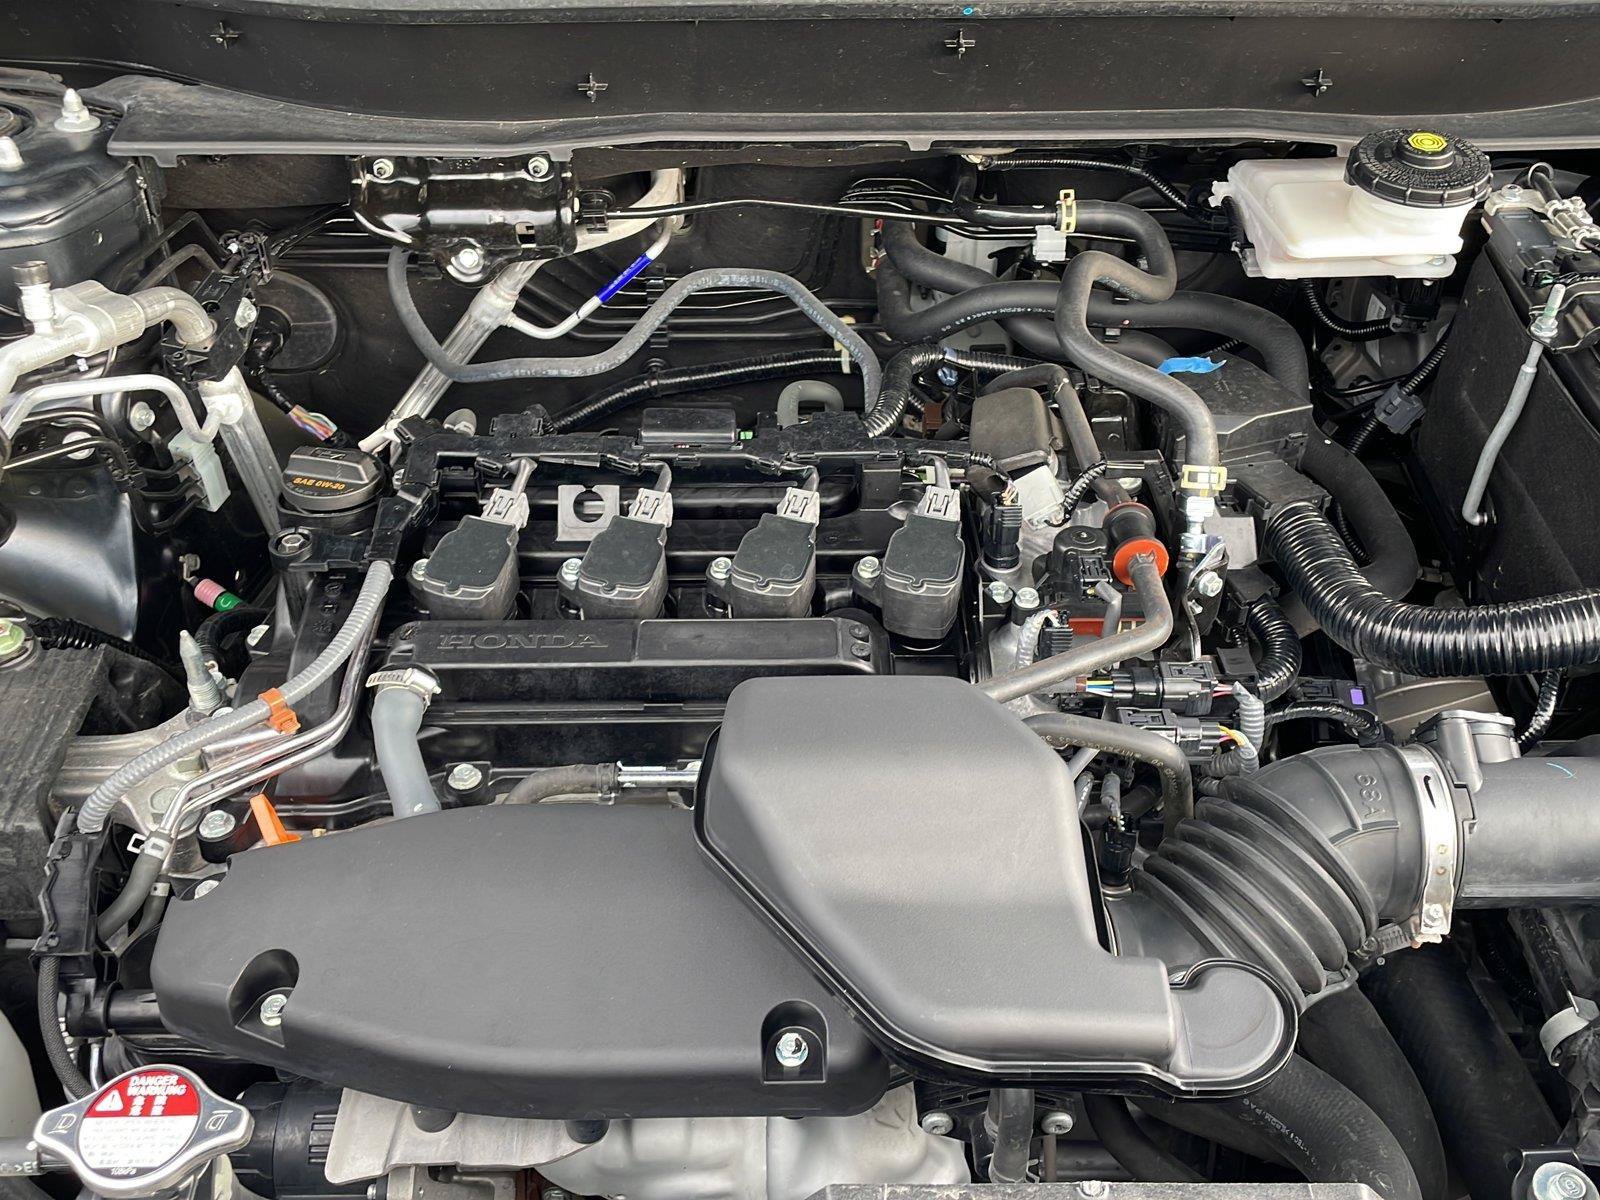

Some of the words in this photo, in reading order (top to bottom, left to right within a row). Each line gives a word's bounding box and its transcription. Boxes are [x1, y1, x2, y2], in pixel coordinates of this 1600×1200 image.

[436, 633, 609, 650] HONDA
[129, 1075, 178, 1085] DANGER
[127, 1085, 187, 1096] WARNING
